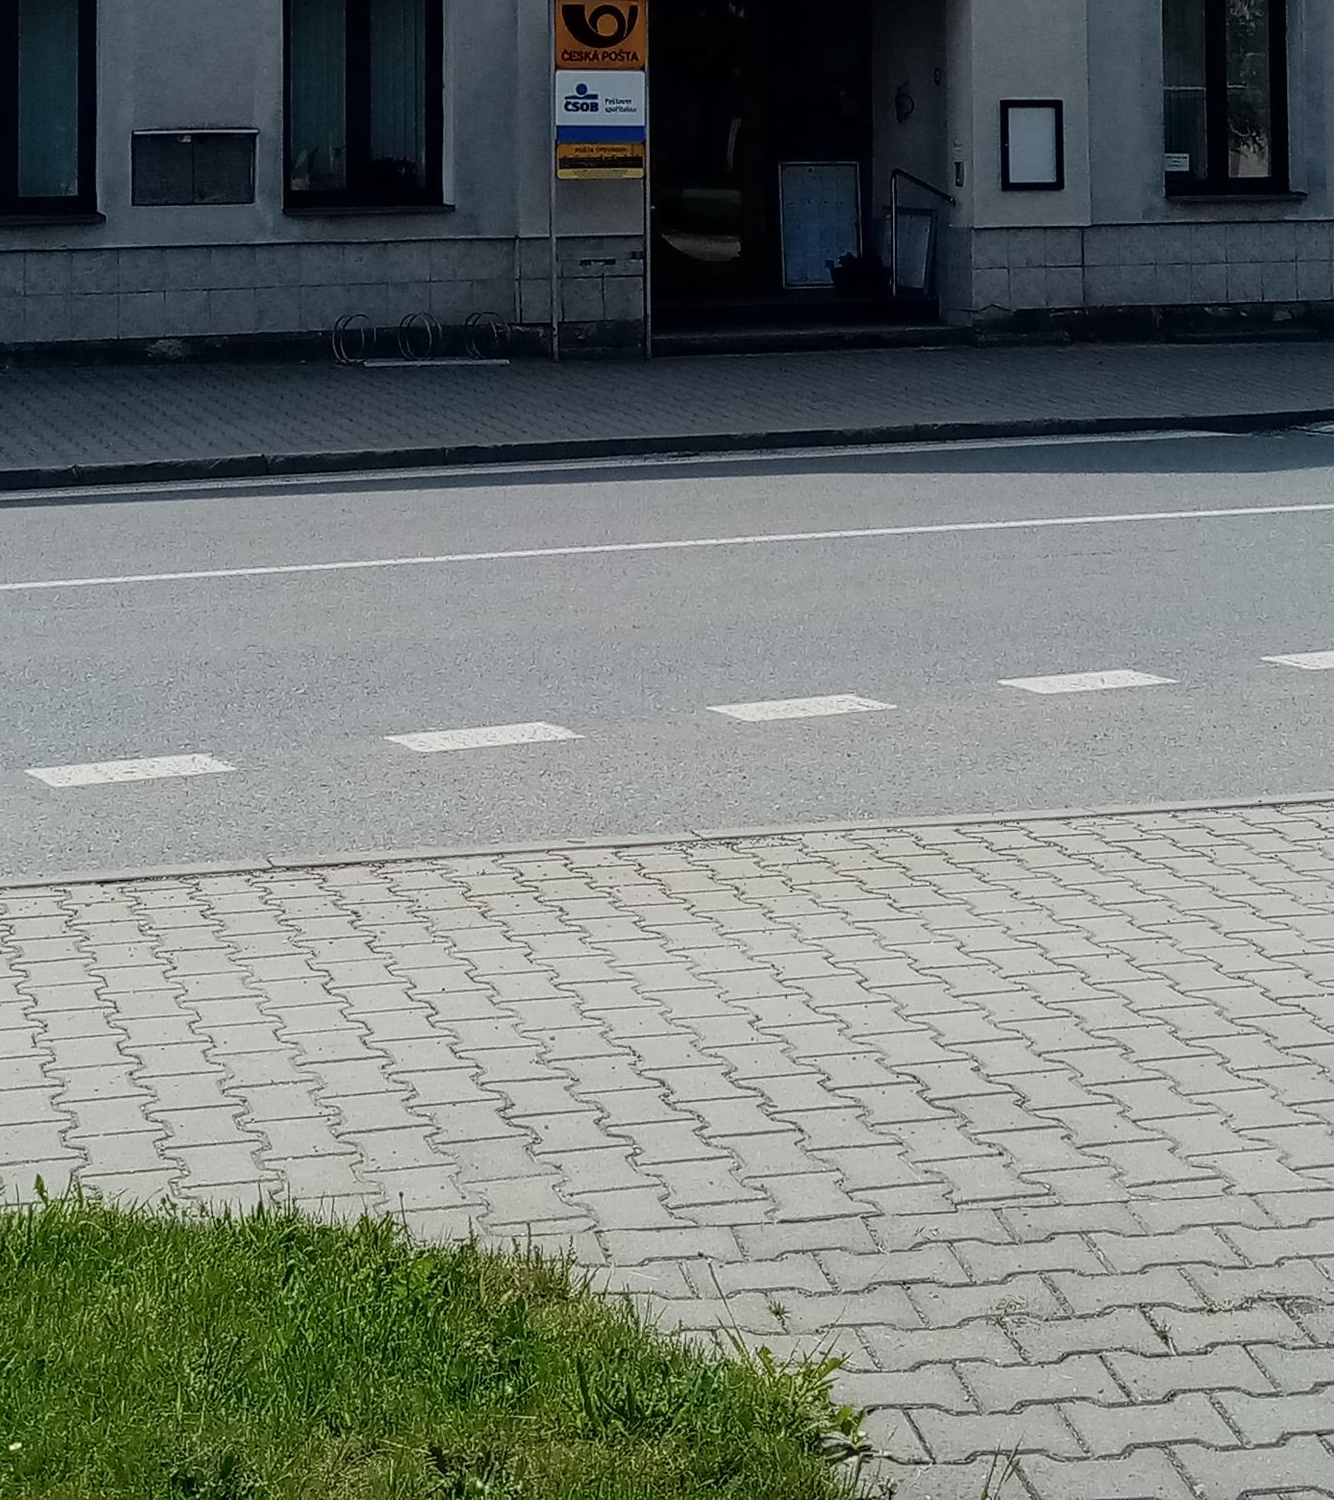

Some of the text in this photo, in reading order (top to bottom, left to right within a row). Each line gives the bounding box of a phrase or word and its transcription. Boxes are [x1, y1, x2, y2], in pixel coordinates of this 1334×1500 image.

[561, 48, 639, 62] ČESKÁ POŠTA
[564, 101, 599, 112] ČSOB
